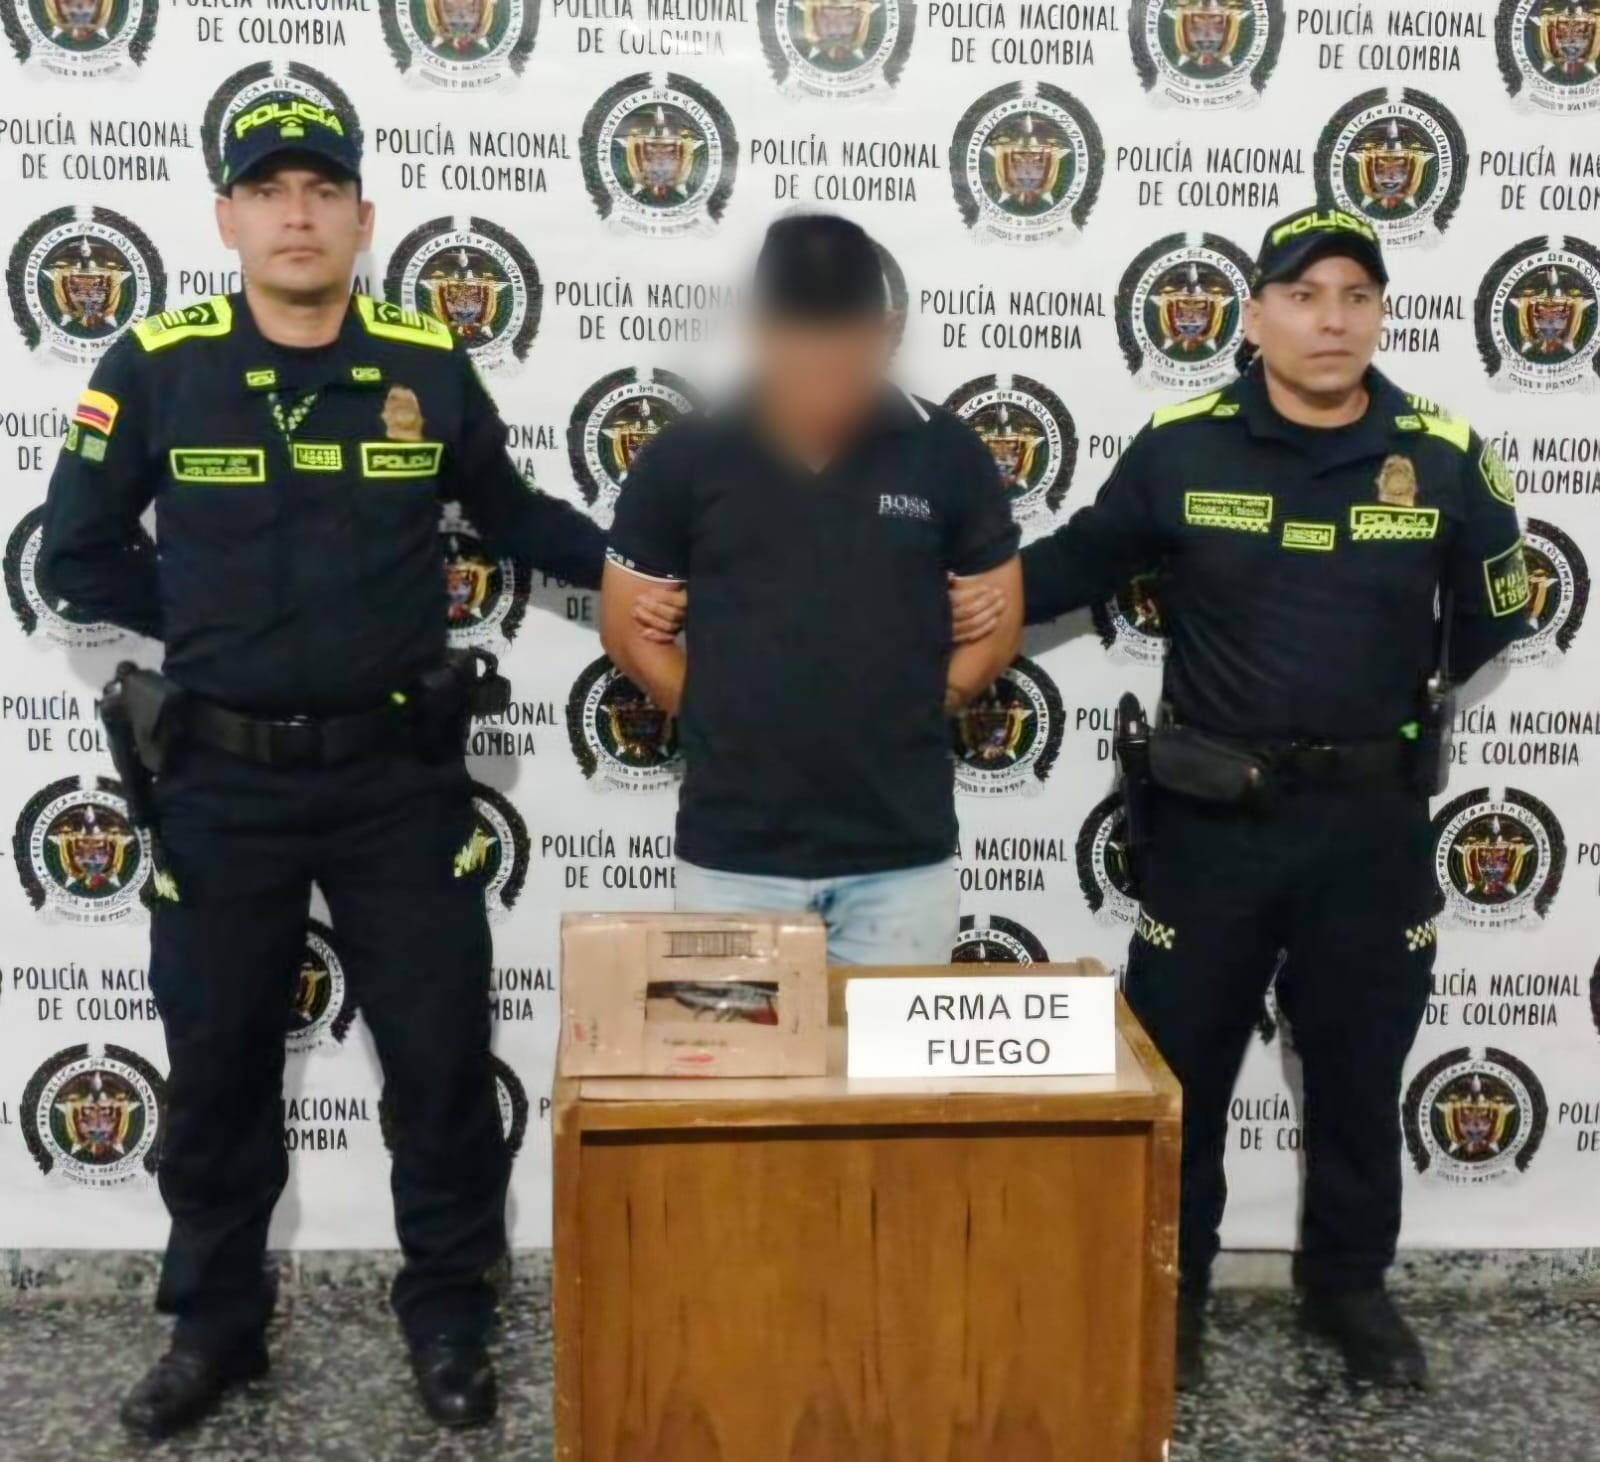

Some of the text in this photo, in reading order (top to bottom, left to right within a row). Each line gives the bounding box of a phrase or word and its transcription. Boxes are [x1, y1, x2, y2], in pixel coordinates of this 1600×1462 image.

[1021, 4, 1118, 31] NACIONAL
[1298, 3, 1486, 38] POLICÍA NACIONAL
[198, 17, 345, 45] DE COLOMBIA
[578, 27, 603, 53] DE
[952, 37, 1093, 65] DE COLOMBIA
[1319, 44, 1460, 71] DE COLOMBIA
[91, 121, 193, 148] NACIONAL
[376, 123, 570, 159] POLICÍA NACIONAL
[751, 134, 940, 168] POLICÍA NACIONAL
[1118, 142, 1304, 174] POLICÍA NACIONAL
[1481, 145, 1555, 177] POLICÍA
[23, 153, 170, 181] DE COLOMBIA
[402, 163, 546, 192] DE COLOMBIA
[775, 175, 916, 202] DE COLOMBIA
[1139, 181, 1278, 207] DE COLOMBIA
[1501, 184, 1526, 210] DE
[180, 271, 243, 296] POLIC
[556, 277, 632, 307] POLICÍA
[921, 284, 1105, 317] POLICÍA NACIONAL
[1383, 293, 1465, 320] ACIONAL
[580, 315, 605, 339] DE
[944, 323, 1081, 349] DE COLOMBIA
[1378, 327, 1440, 353] OMBIA
[506, 424, 558, 451] ONAL
[18, 446, 42, 470] DE
[1515, 470, 1600, 494] OLOMBIA
[567, 598, 592, 622] DE
[3, 691, 79, 720] POLICÍA
[28, 728, 52, 751] DE
[1482, 742, 1578, 766] COLOMBIA
[542, 829, 673, 860] POLICÍA NACI
[976, 838, 1067, 862] NACIONAL
[566, 866, 588, 888] DE
[954, 867, 1045, 891] OLOMBIA
[14, 962, 149, 991] POLICÍA NACI
[1431, 969, 1579, 997] LICÍA NACIONAL
[39, 997, 156, 1021] DE COLOMB
[907, 994, 1069, 1021] ARMA DE
[1426, 1003, 1557, 1025] DE COLOMBIA
[929, 1039, 1050, 1065] FUEGO
[284, 1098, 370, 1121] ACIONAL
[1231, 1094, 1289, 1120] OLICÍA
[1559, 1102, 1599, 1124] POLI
[286, 1128, 348, 1151] OMBIA
[1240, 1127, 1261, 1150] DE
